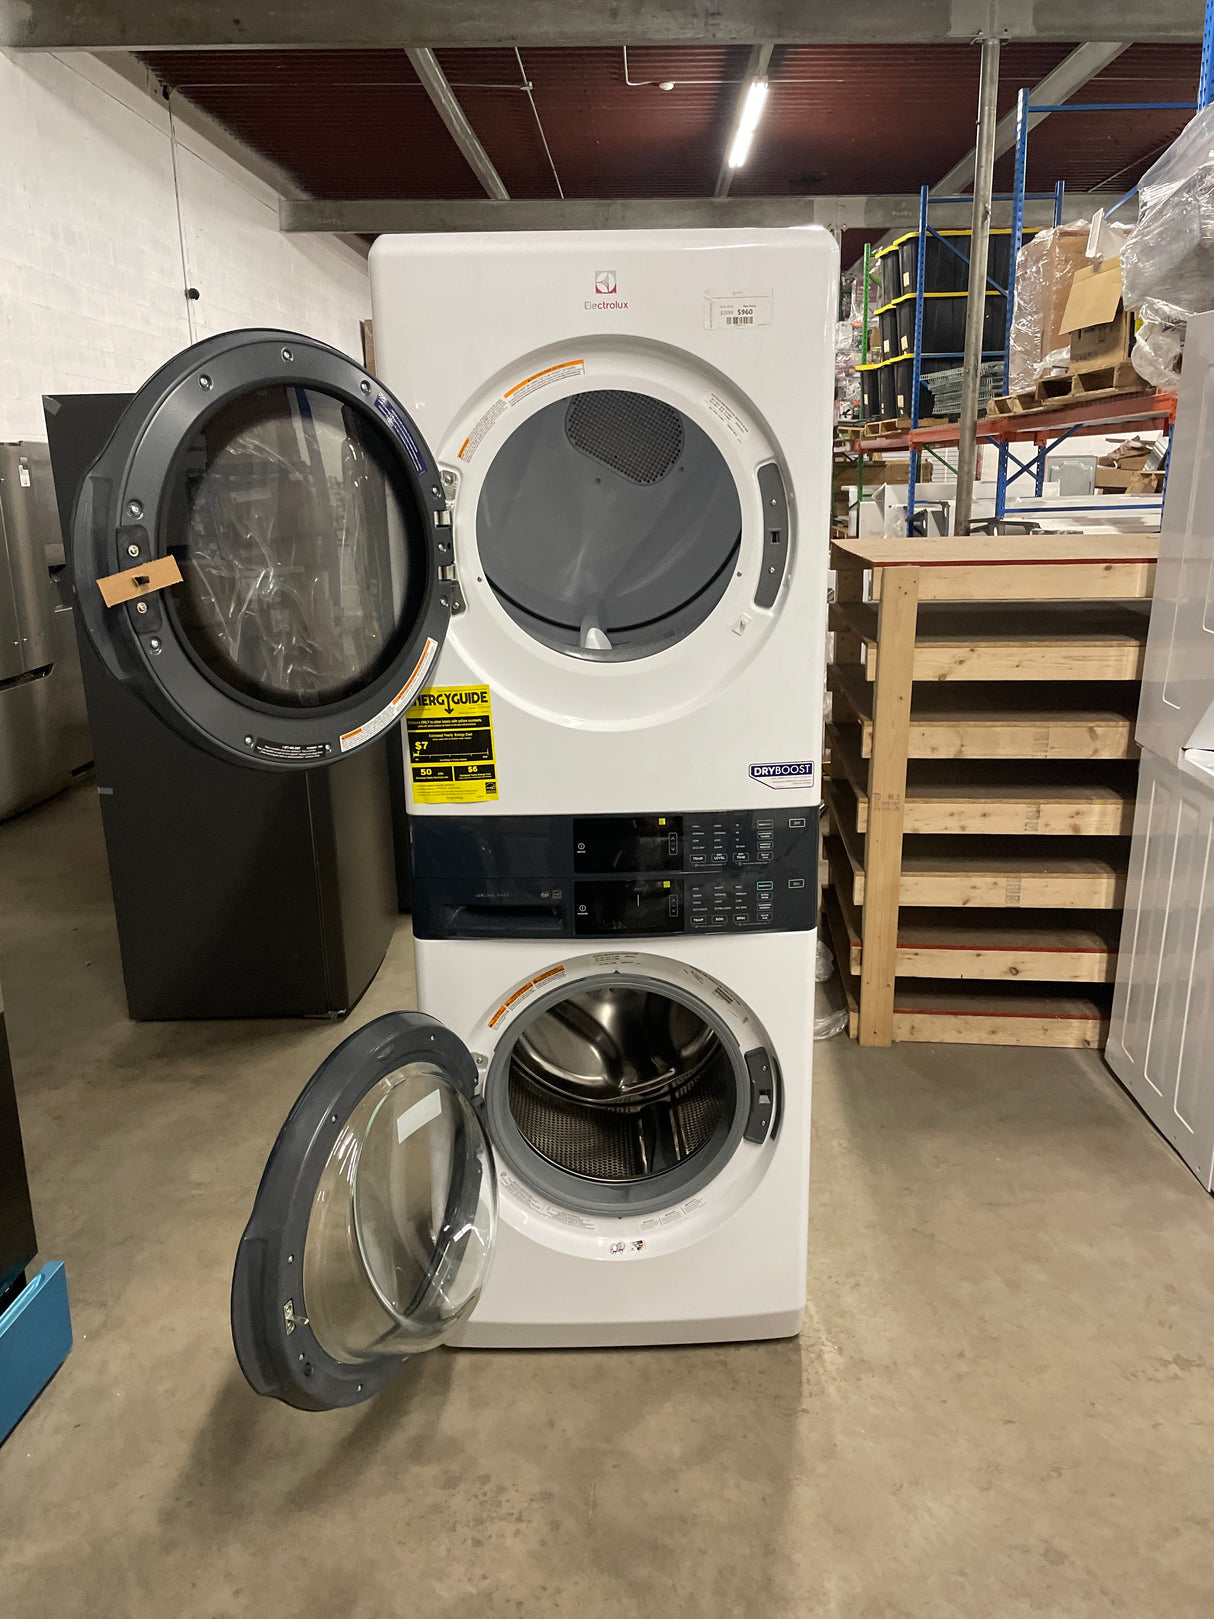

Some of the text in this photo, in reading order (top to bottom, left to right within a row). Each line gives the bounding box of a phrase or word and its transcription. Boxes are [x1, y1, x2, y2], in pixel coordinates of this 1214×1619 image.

[584, 301, 629, 310] Electrolux
[737, 308, 753, 316] $960
[412, 691, 488, 711] NERGYGUIDE
[415, 741, 428, 751] $7
[420, 768, 432, 776] 50
[753, 764, 811, 776] DRYBOOST
